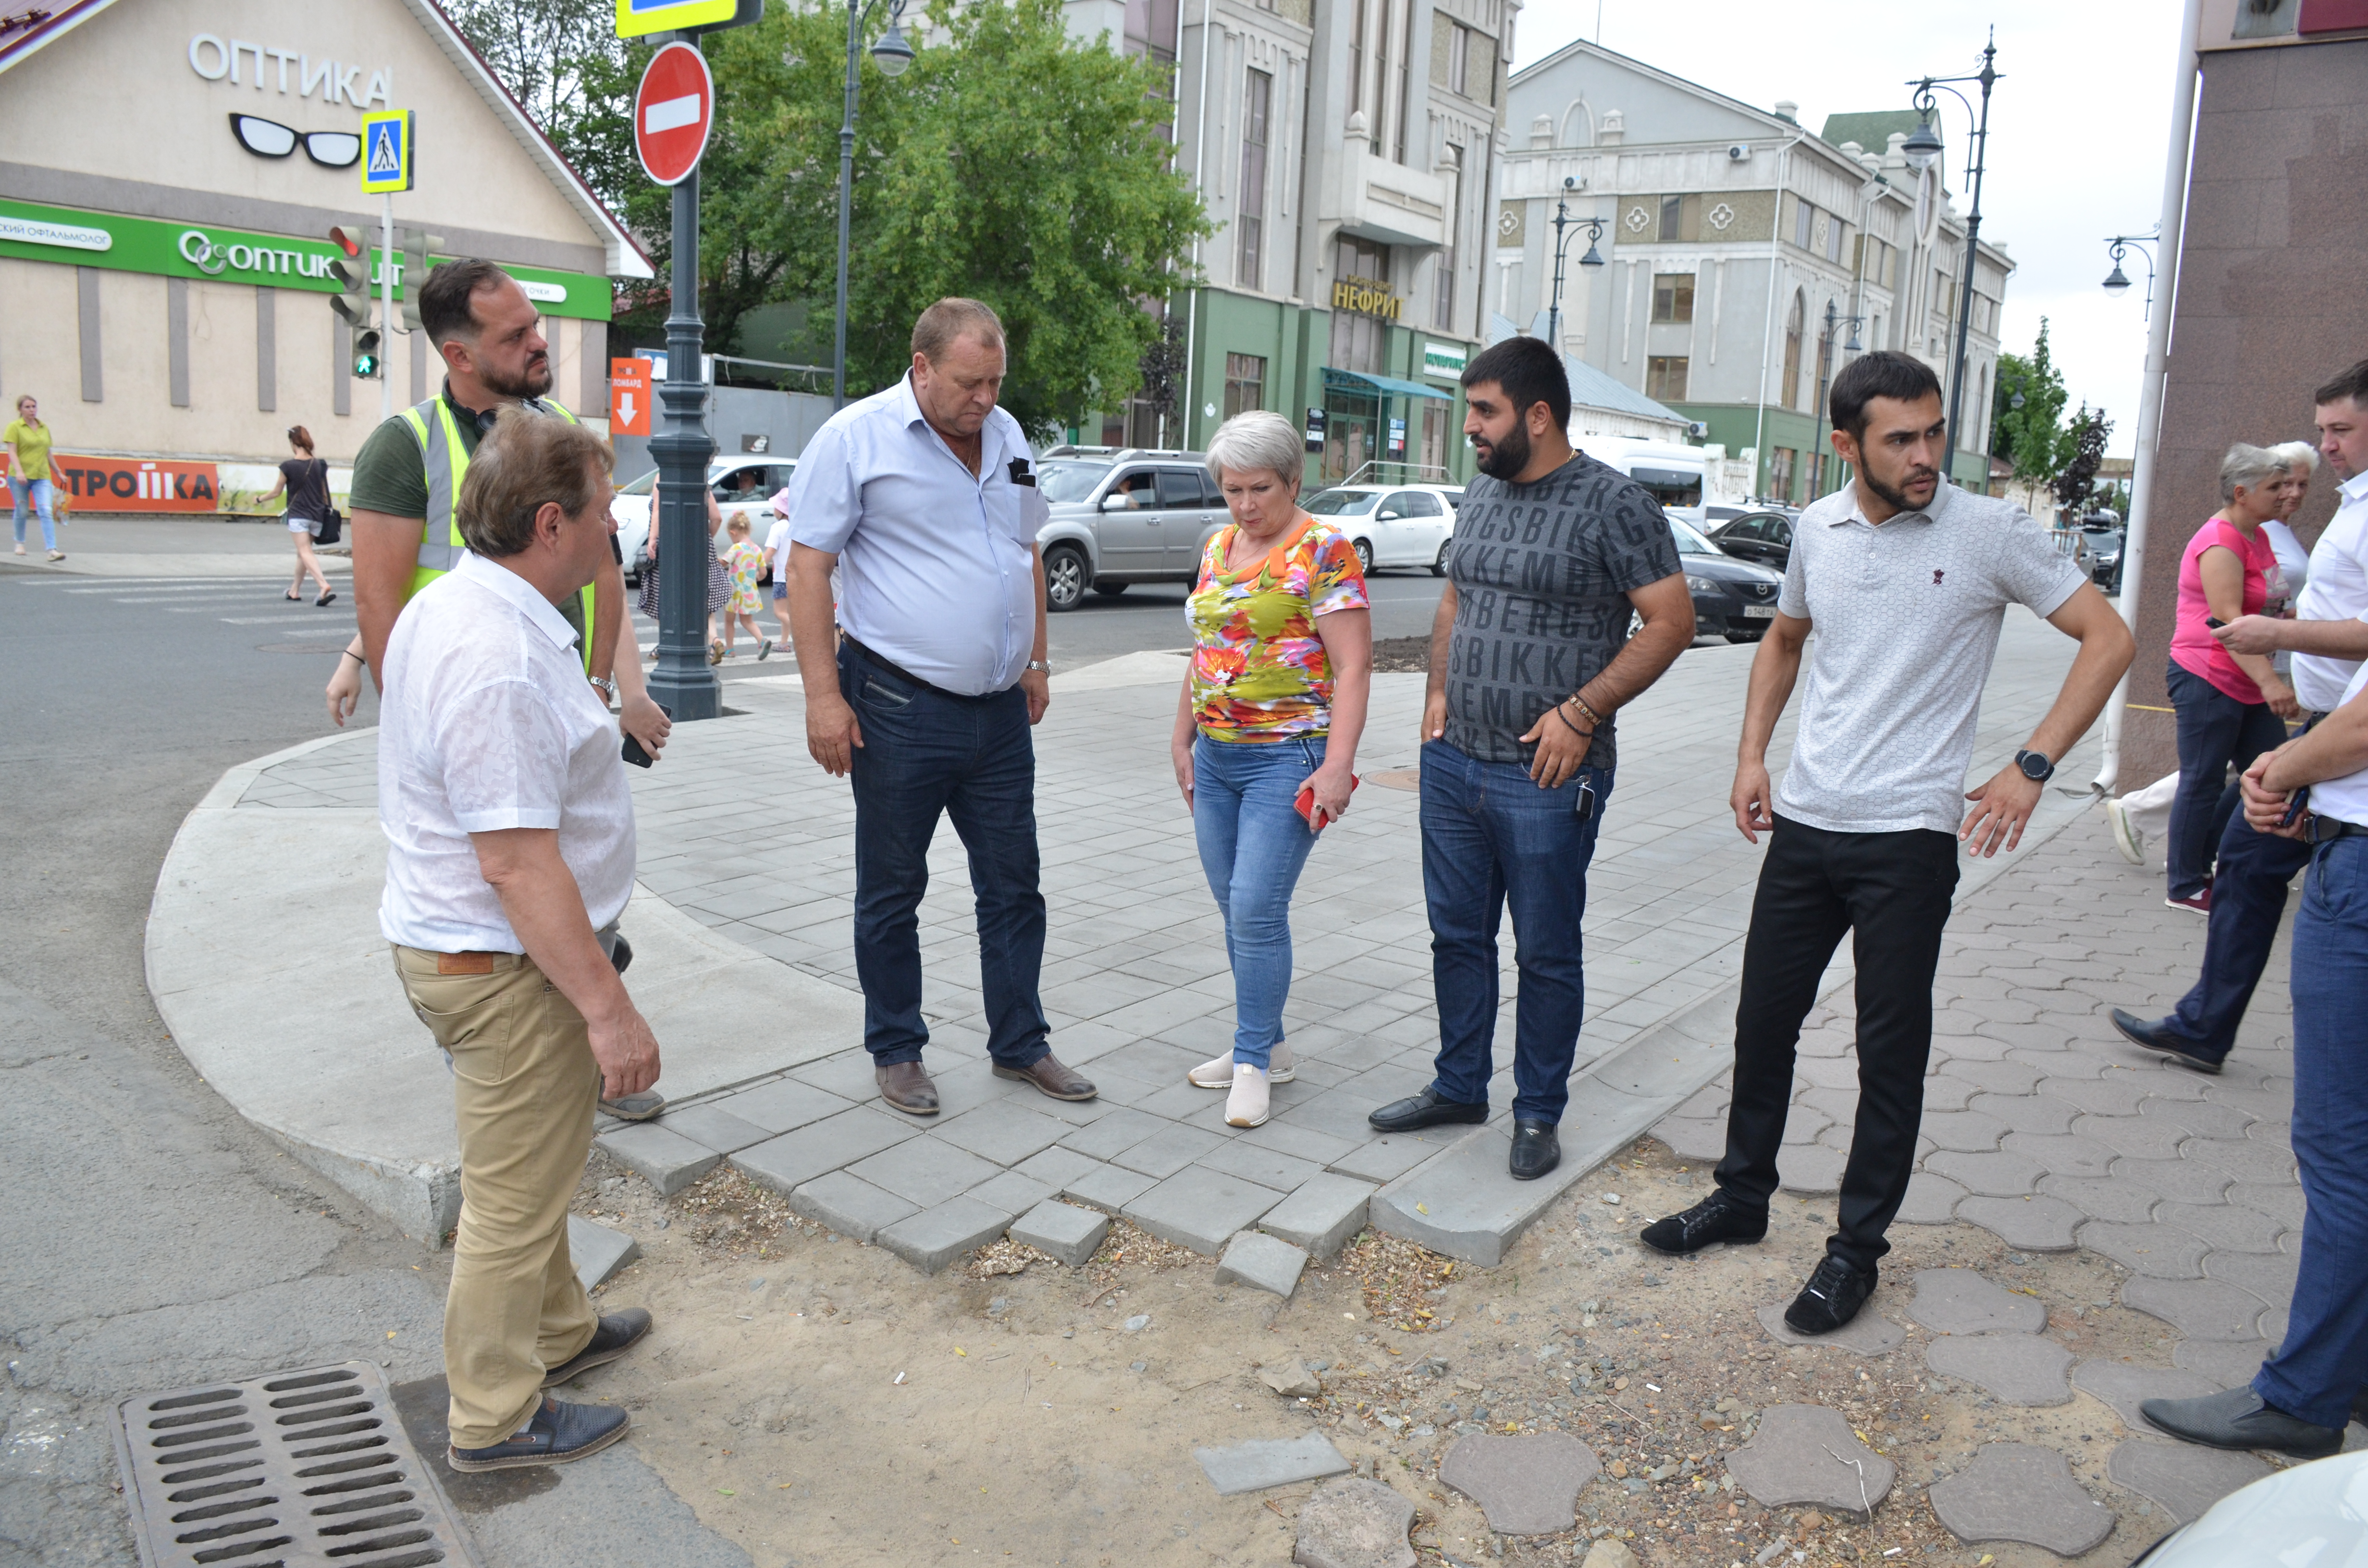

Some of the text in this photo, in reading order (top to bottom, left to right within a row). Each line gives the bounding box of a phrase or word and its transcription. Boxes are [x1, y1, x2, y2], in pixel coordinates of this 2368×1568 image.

[189, 33, 386, 109] ОПТИКА
[27, 227, 108, 245] ОФТАЛЬМОЛОГ
[529, 287, 550, 295] ОЧКИ
[1332, 282, 1405, 319] НЕФРИТ
[613, 378, 642, 389] ЛОМБАРД
[65, 463, 214, 500] ТРОЙКА
